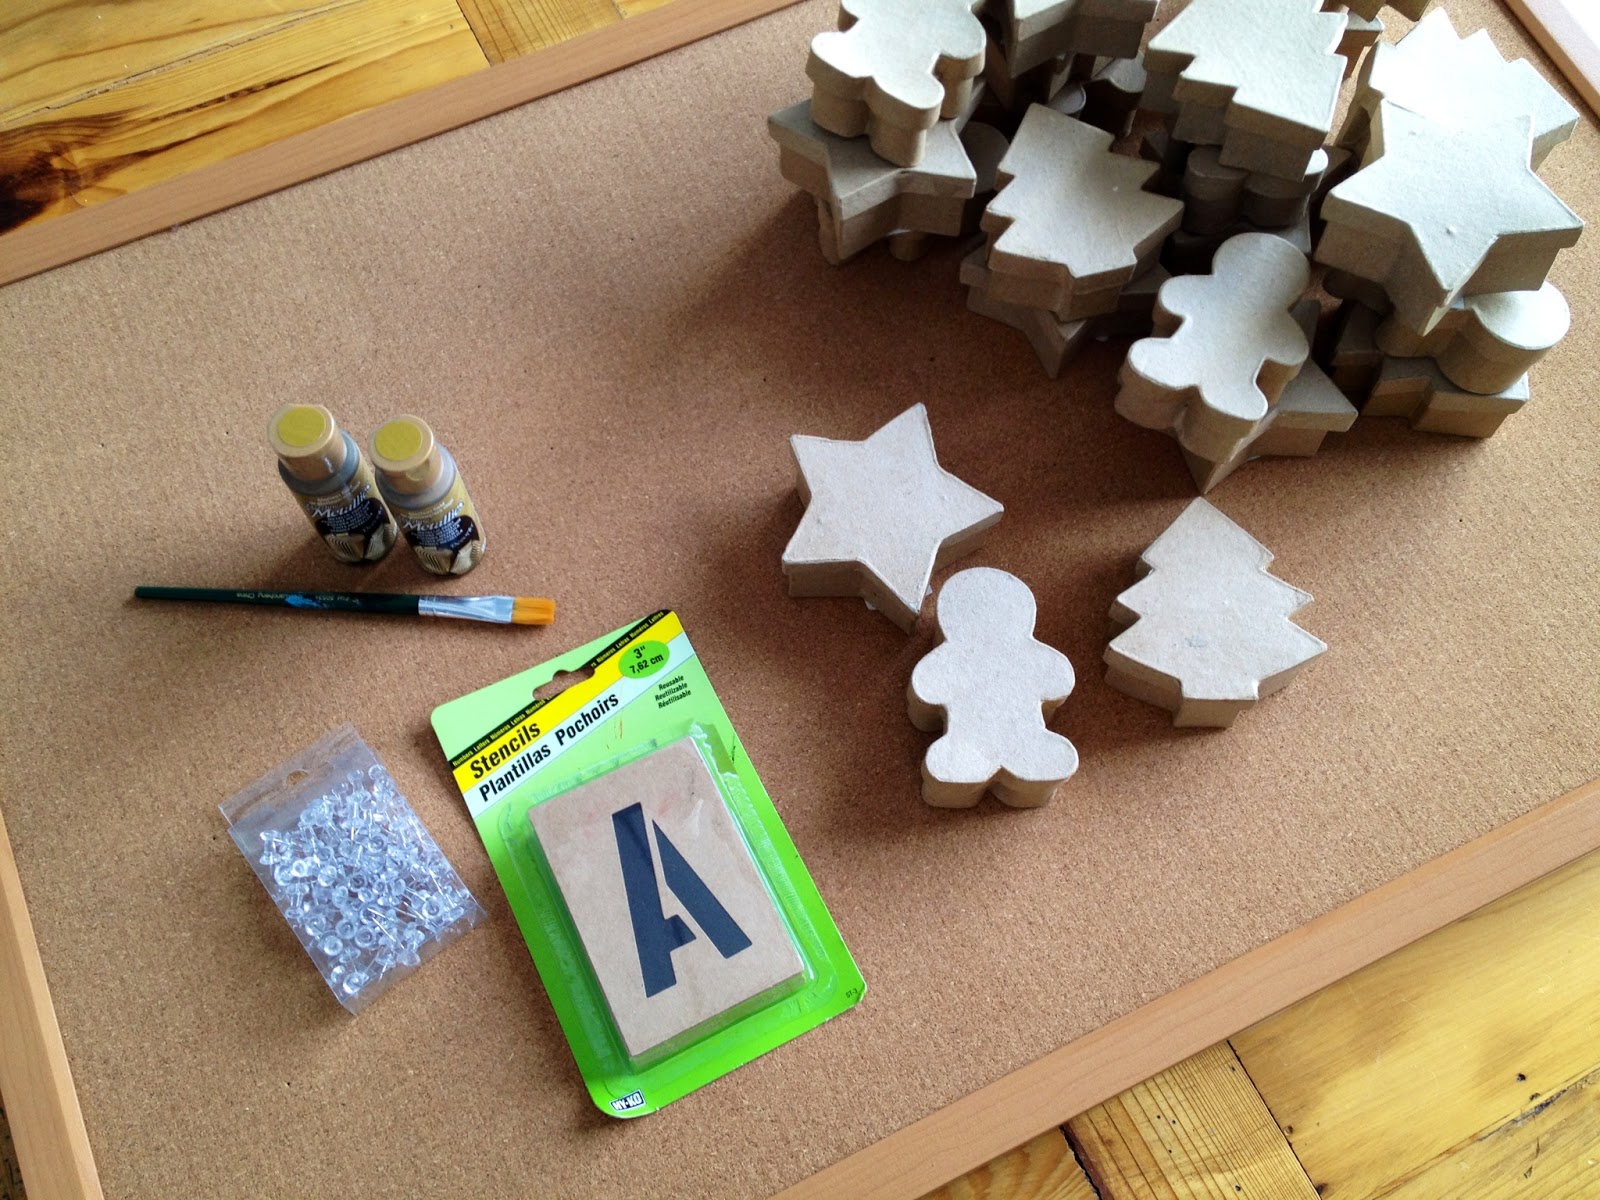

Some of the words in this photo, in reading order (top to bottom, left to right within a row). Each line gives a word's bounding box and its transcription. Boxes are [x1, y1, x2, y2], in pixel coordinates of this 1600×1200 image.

[629, 659, 648, 674] 7,62
[649, 653, 664, 665] cm
[658, 675, 684, 690] Reusable
[655, 682, 688, 701] Reutilizable
[470, 722, 541, 779] Stencils
[478, 743, 551, 802] Plantillas
[554, 693, 619, 746] Pochoirs
[611, 801, 753, 999] A
